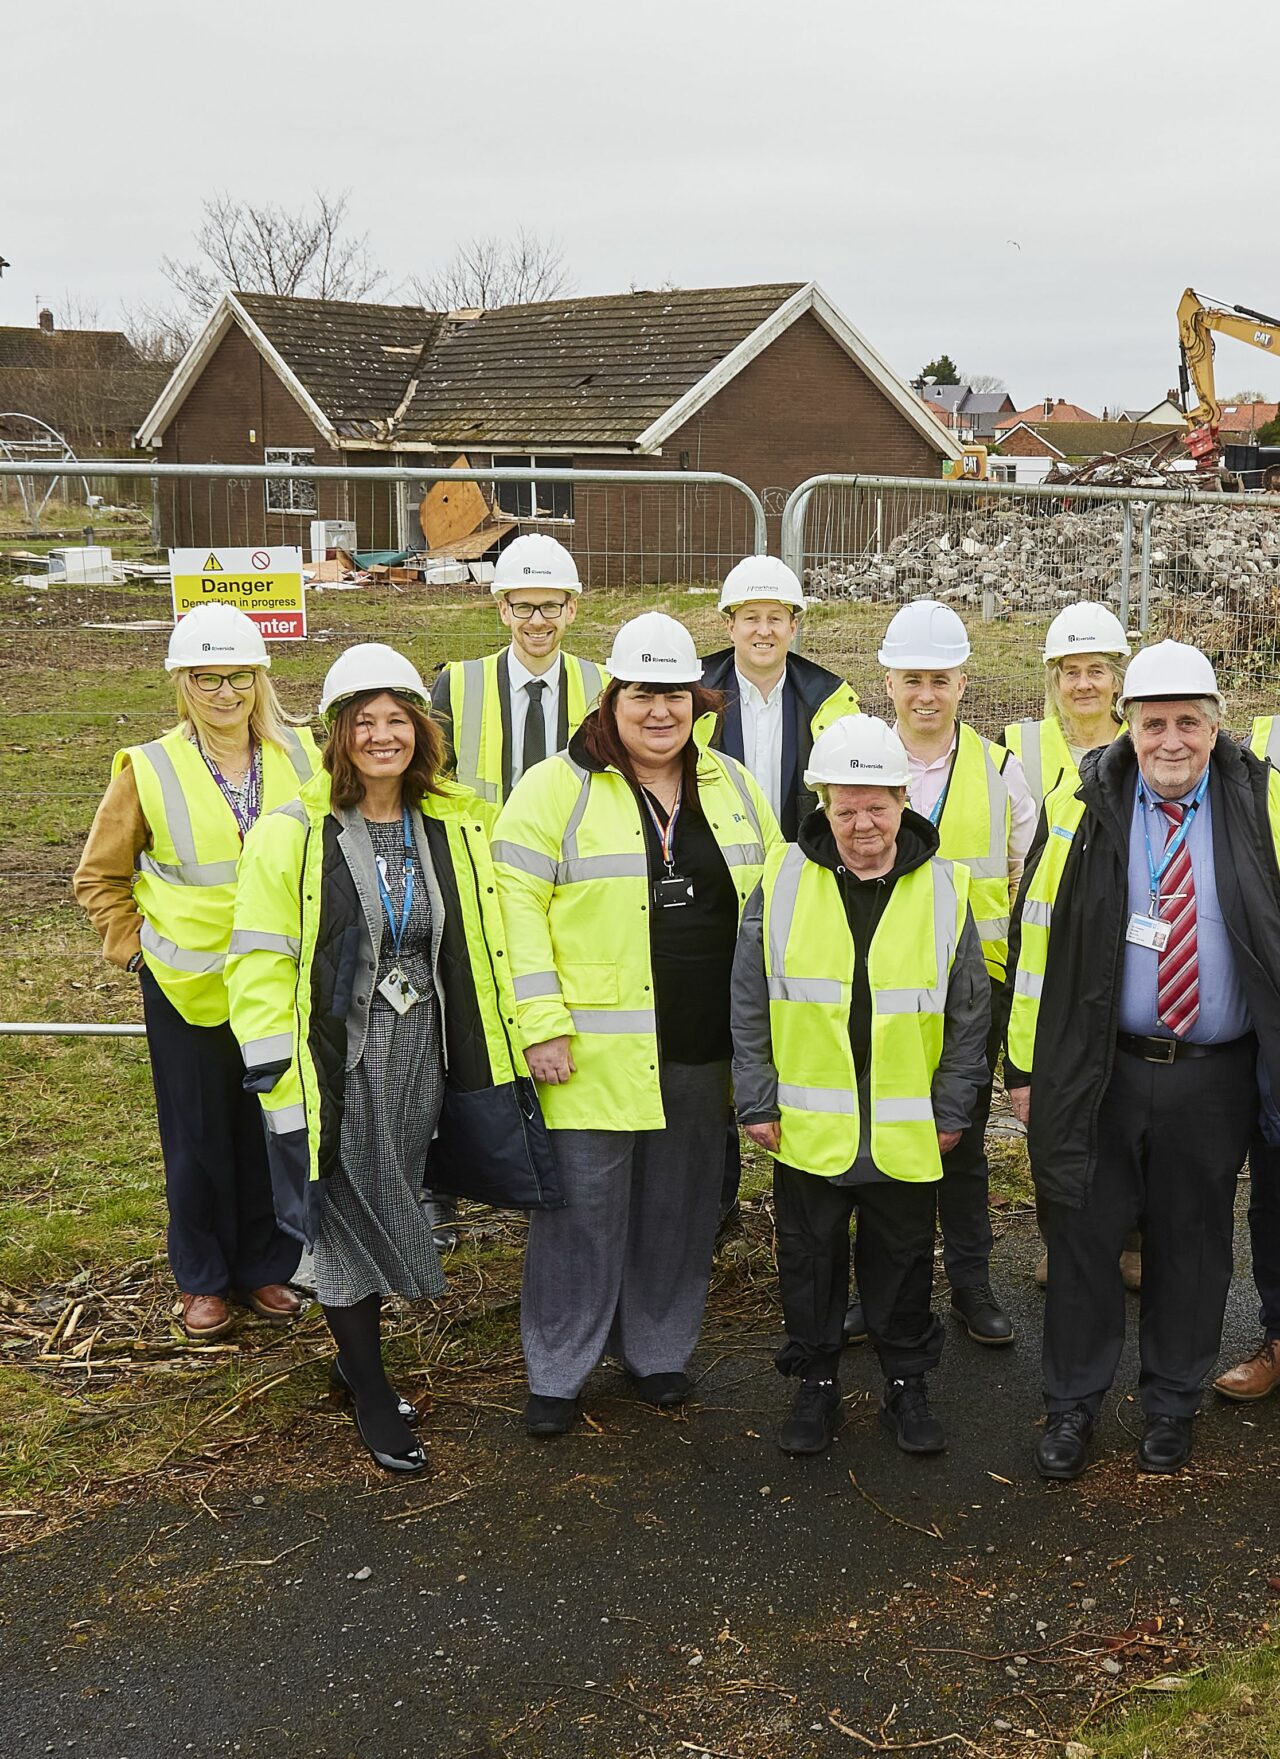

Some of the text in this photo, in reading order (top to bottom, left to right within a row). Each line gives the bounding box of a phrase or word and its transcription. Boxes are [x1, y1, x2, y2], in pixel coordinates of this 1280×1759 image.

[1254, 331, 1271, 345] CAT
[963, 456, 977, 473] CAT
[202, 579, 273, 595] Danger
[240, 598, 248, 607] in
[252, 598, 296, 608] progress
